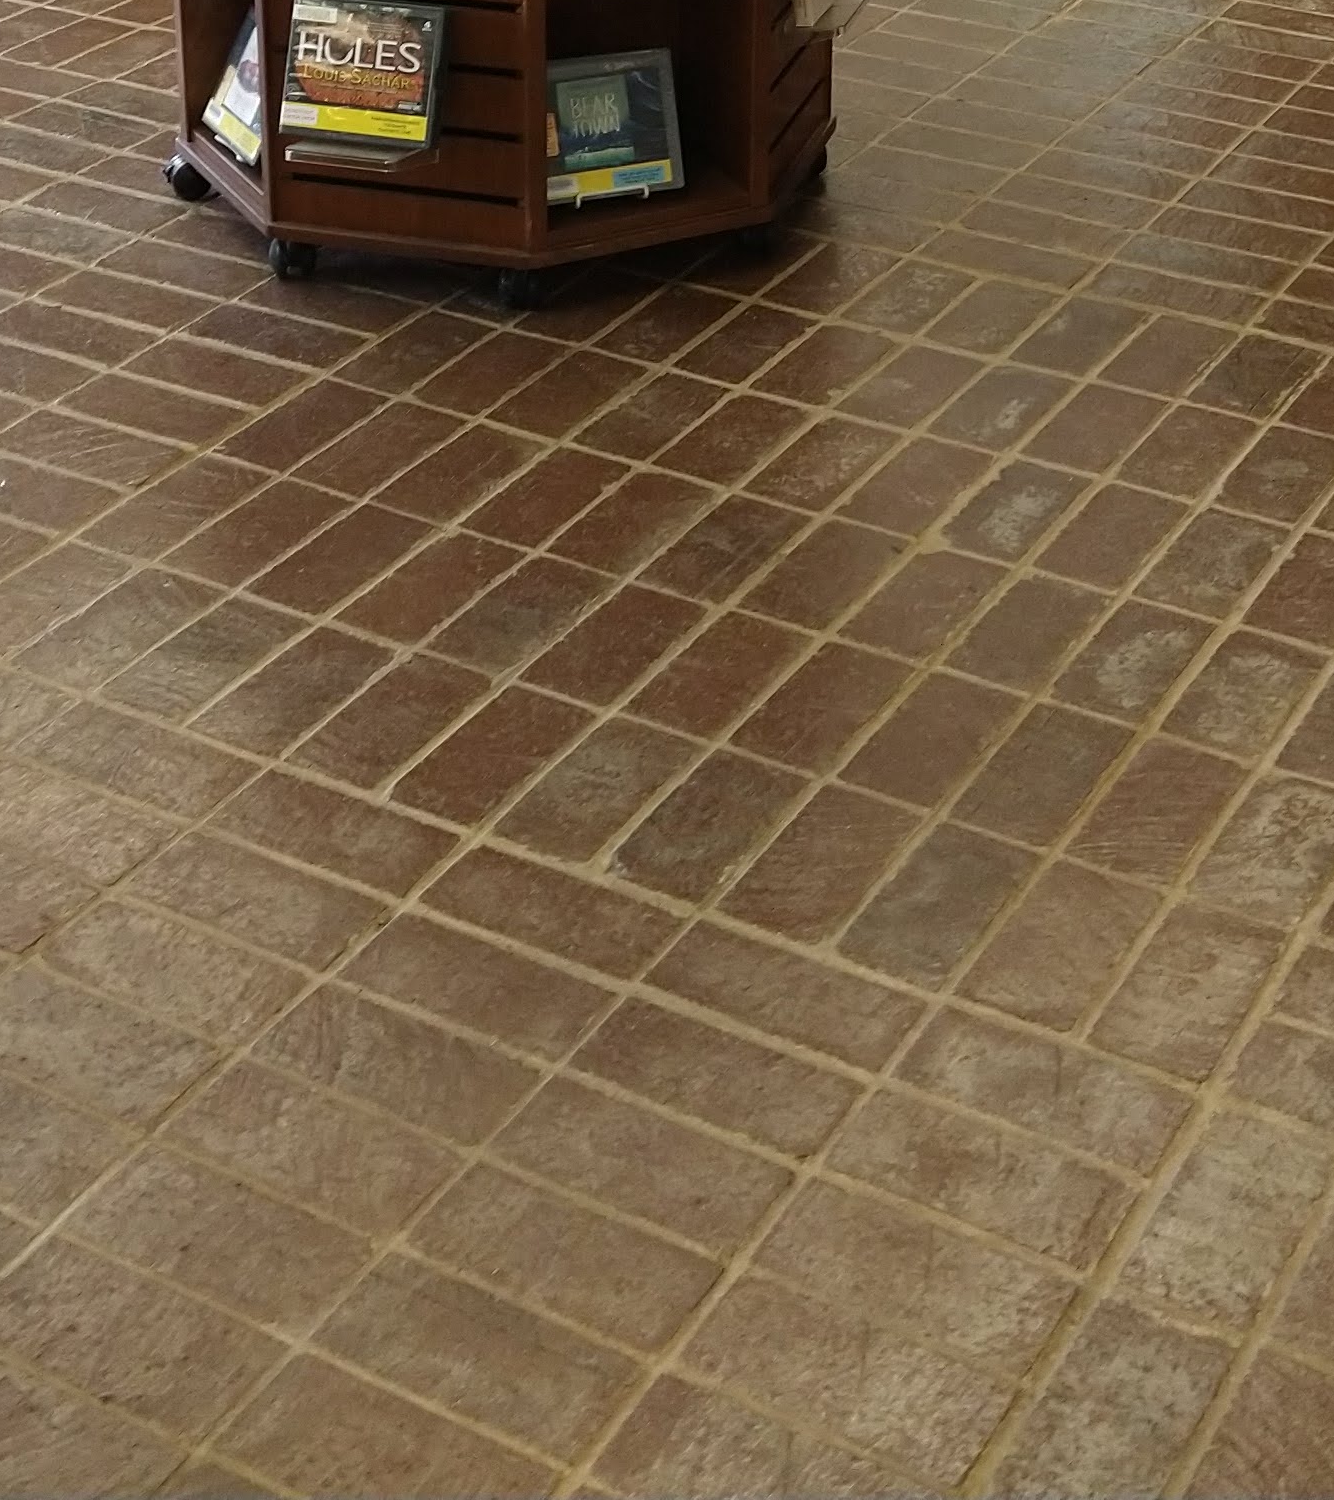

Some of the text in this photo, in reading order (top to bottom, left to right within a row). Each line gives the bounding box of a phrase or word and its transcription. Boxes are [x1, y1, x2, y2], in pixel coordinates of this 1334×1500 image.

[293, 30, 423, 75] HOLES
[569, 92, 617, 120] BEAR
[574, 113, 620, 139] TOWN
